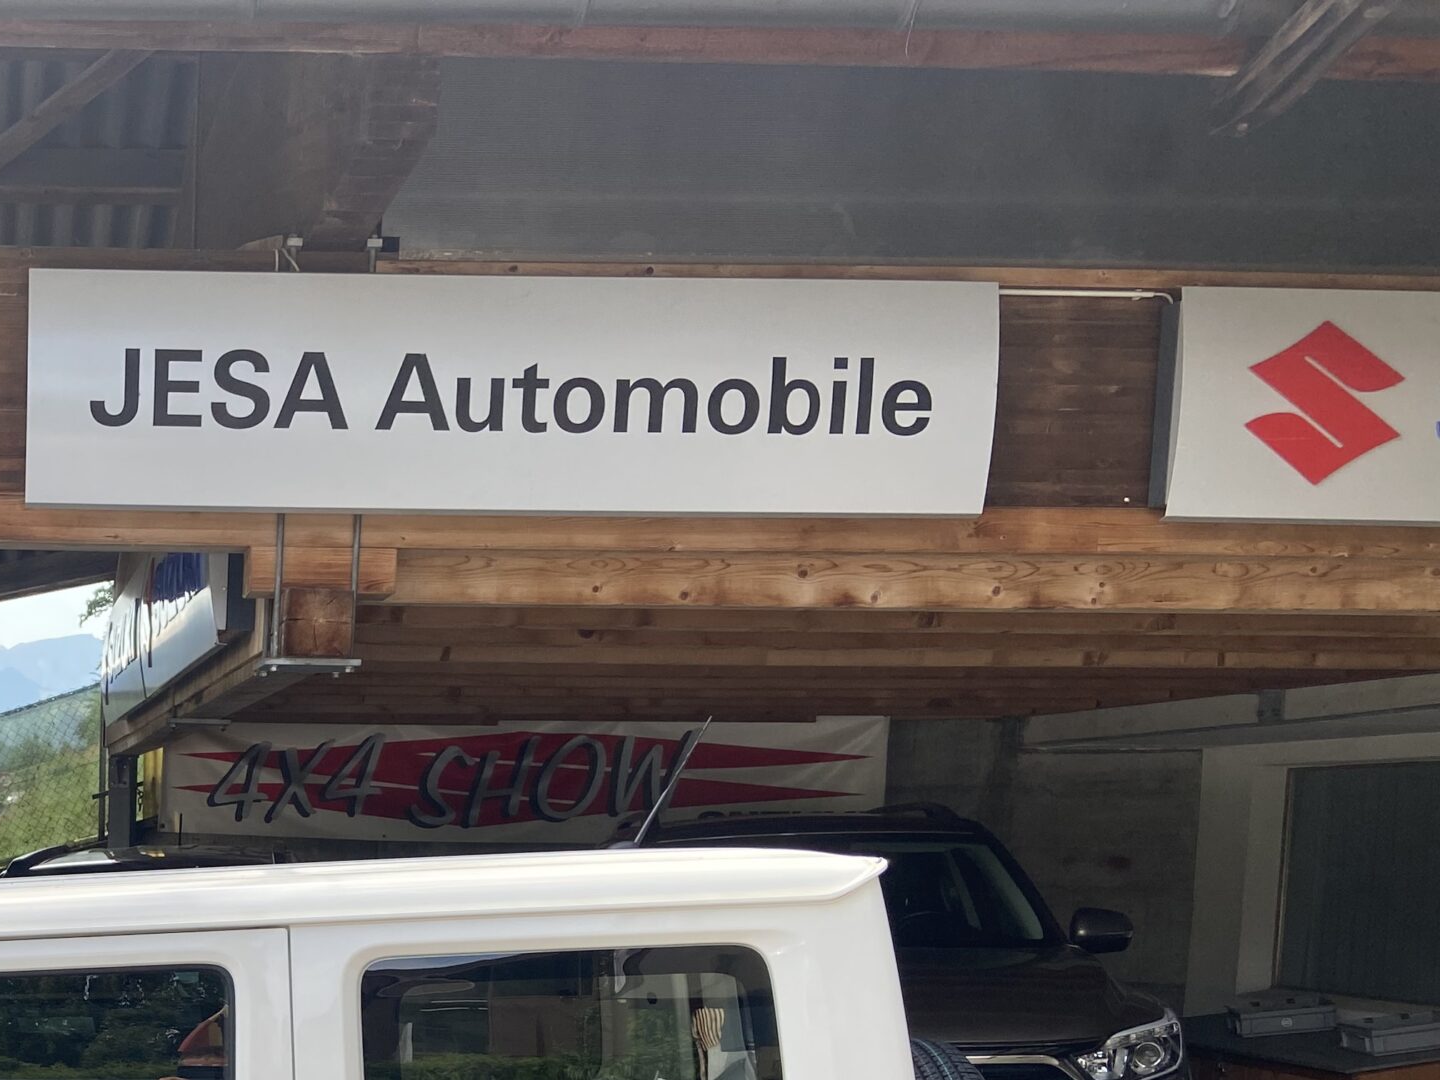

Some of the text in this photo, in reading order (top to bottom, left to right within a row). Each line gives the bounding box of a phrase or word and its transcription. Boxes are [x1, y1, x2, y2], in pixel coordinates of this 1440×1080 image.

[89, 347, 933, 436] JESA Automobile
[406, 727, 704, 829] SHOW
